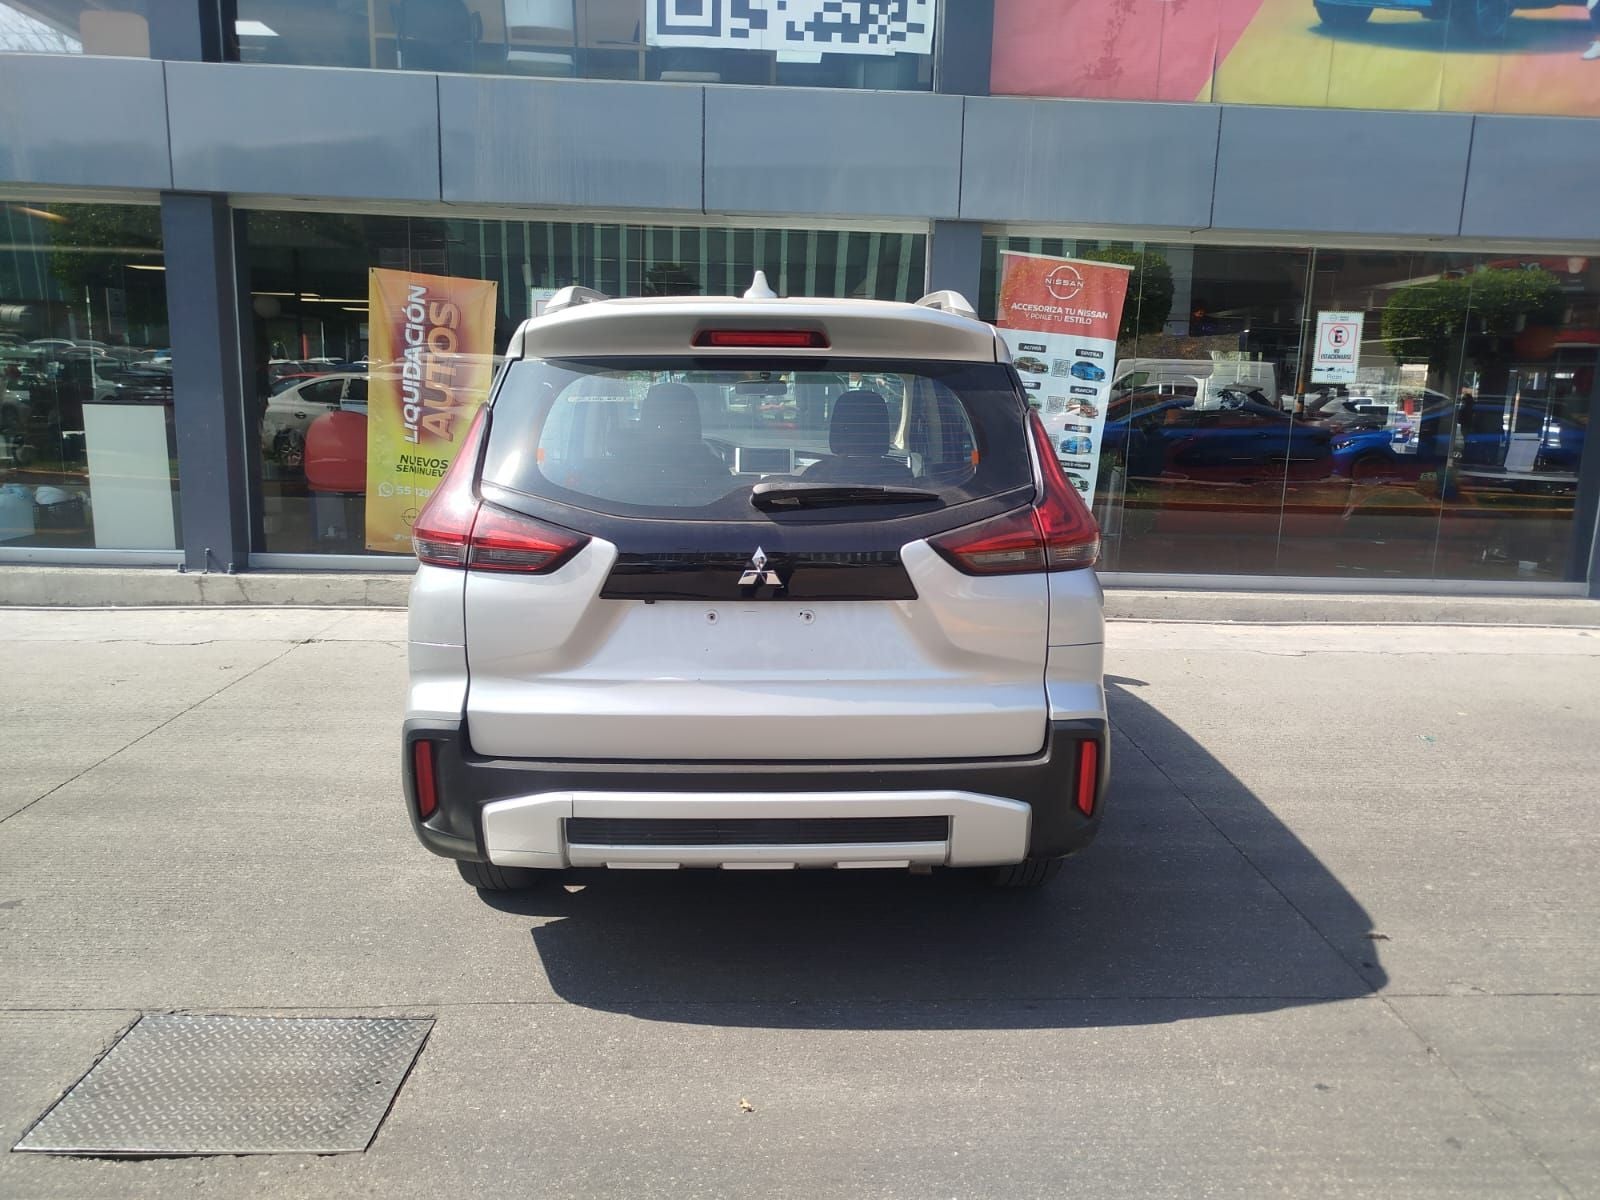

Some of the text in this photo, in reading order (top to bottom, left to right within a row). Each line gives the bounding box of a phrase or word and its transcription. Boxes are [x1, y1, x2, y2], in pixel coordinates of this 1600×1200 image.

[1045, 278, 1084, 288] NISSAN
[1011, 302, 1109, 319] ACCESORIZA TU NISSAN
[1064, 315, 1092, 325] ESTILO
[402, 284, 428, 444] LIQUIDACIÓN
[422, 301, 460, 441] AUTOS
[400, 454, 449, 469] NUEVOS
[395, 464, 447, 477] SEMINUEV
